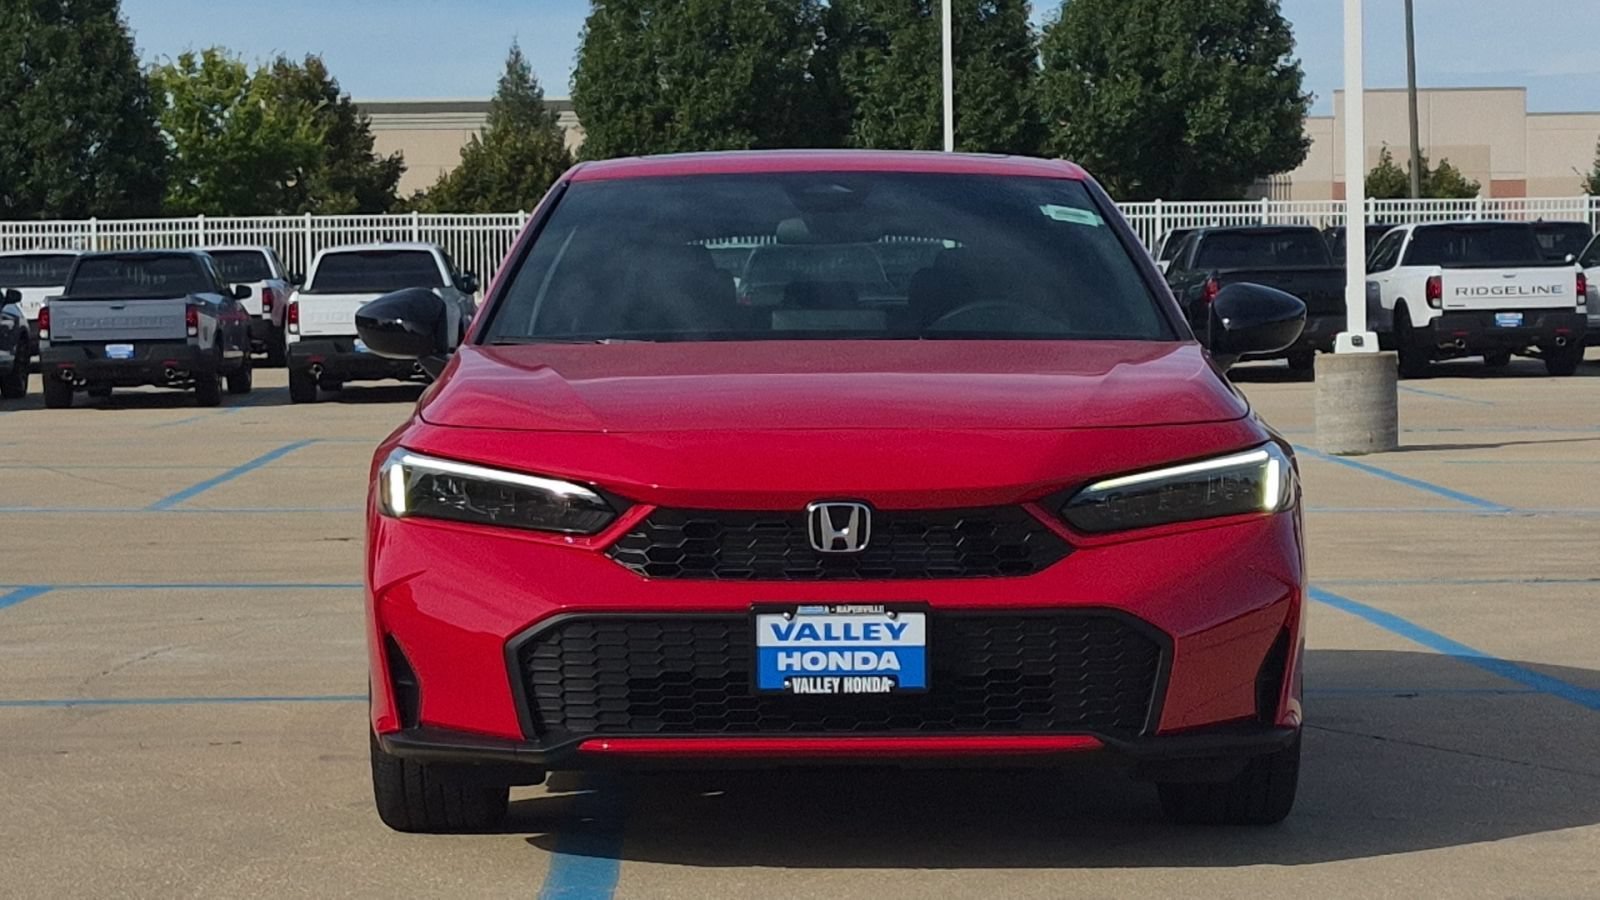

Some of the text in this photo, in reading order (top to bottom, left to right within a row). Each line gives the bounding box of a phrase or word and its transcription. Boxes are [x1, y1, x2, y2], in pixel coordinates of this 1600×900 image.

[1455, 285, 1563, 296] RIDGELINE
[771, 623, 908, 641] VALLEY
[777, 651, 901, 671] HONDA
[792, 676, 890, 694] VALLEY HONDA
